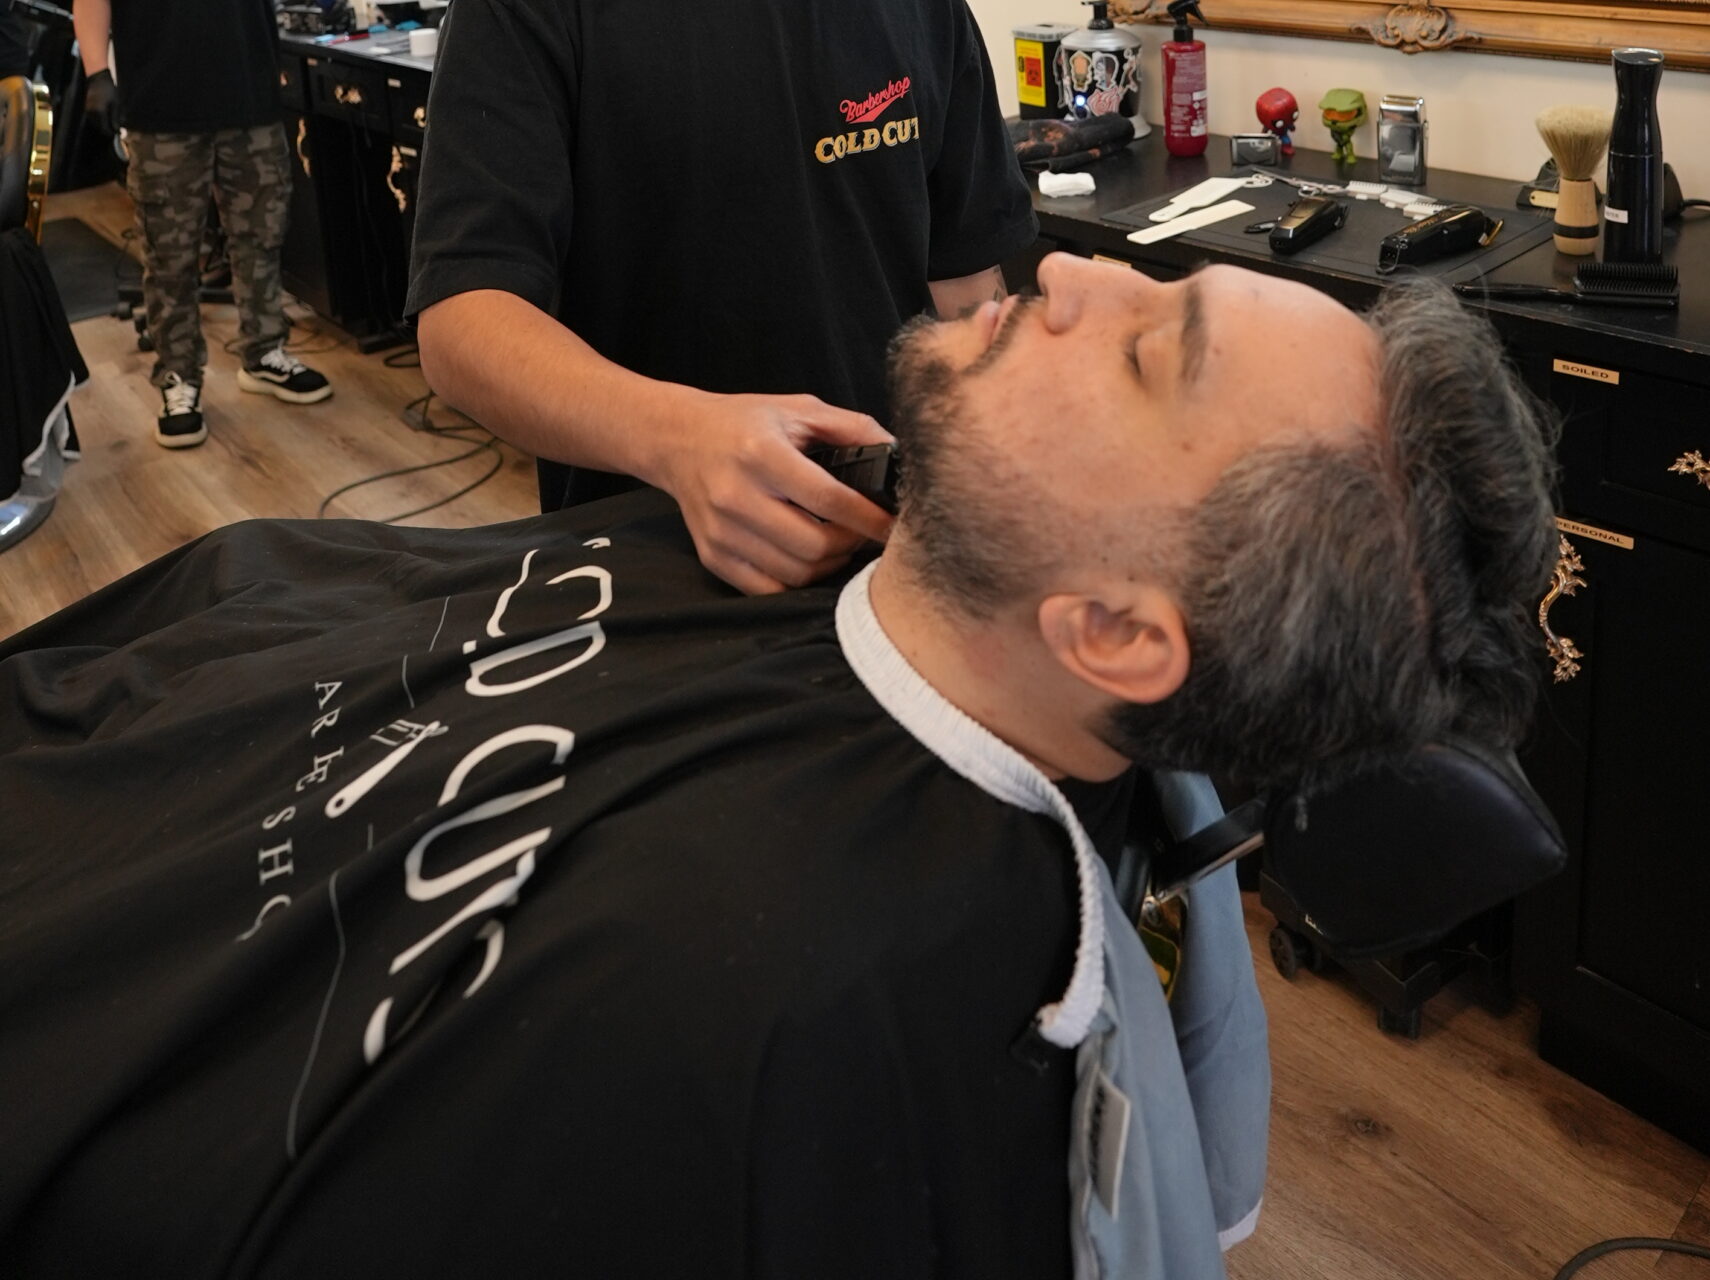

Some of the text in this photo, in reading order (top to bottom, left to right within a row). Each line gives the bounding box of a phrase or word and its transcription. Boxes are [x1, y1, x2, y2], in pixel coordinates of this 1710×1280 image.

[840, 76, 911, 122] Barbershop
[814, 127, 881, 163] COLD
[1562, 365, 1609, 379] SOILED
[1556, 520, 1625, 545] PERSONAL
